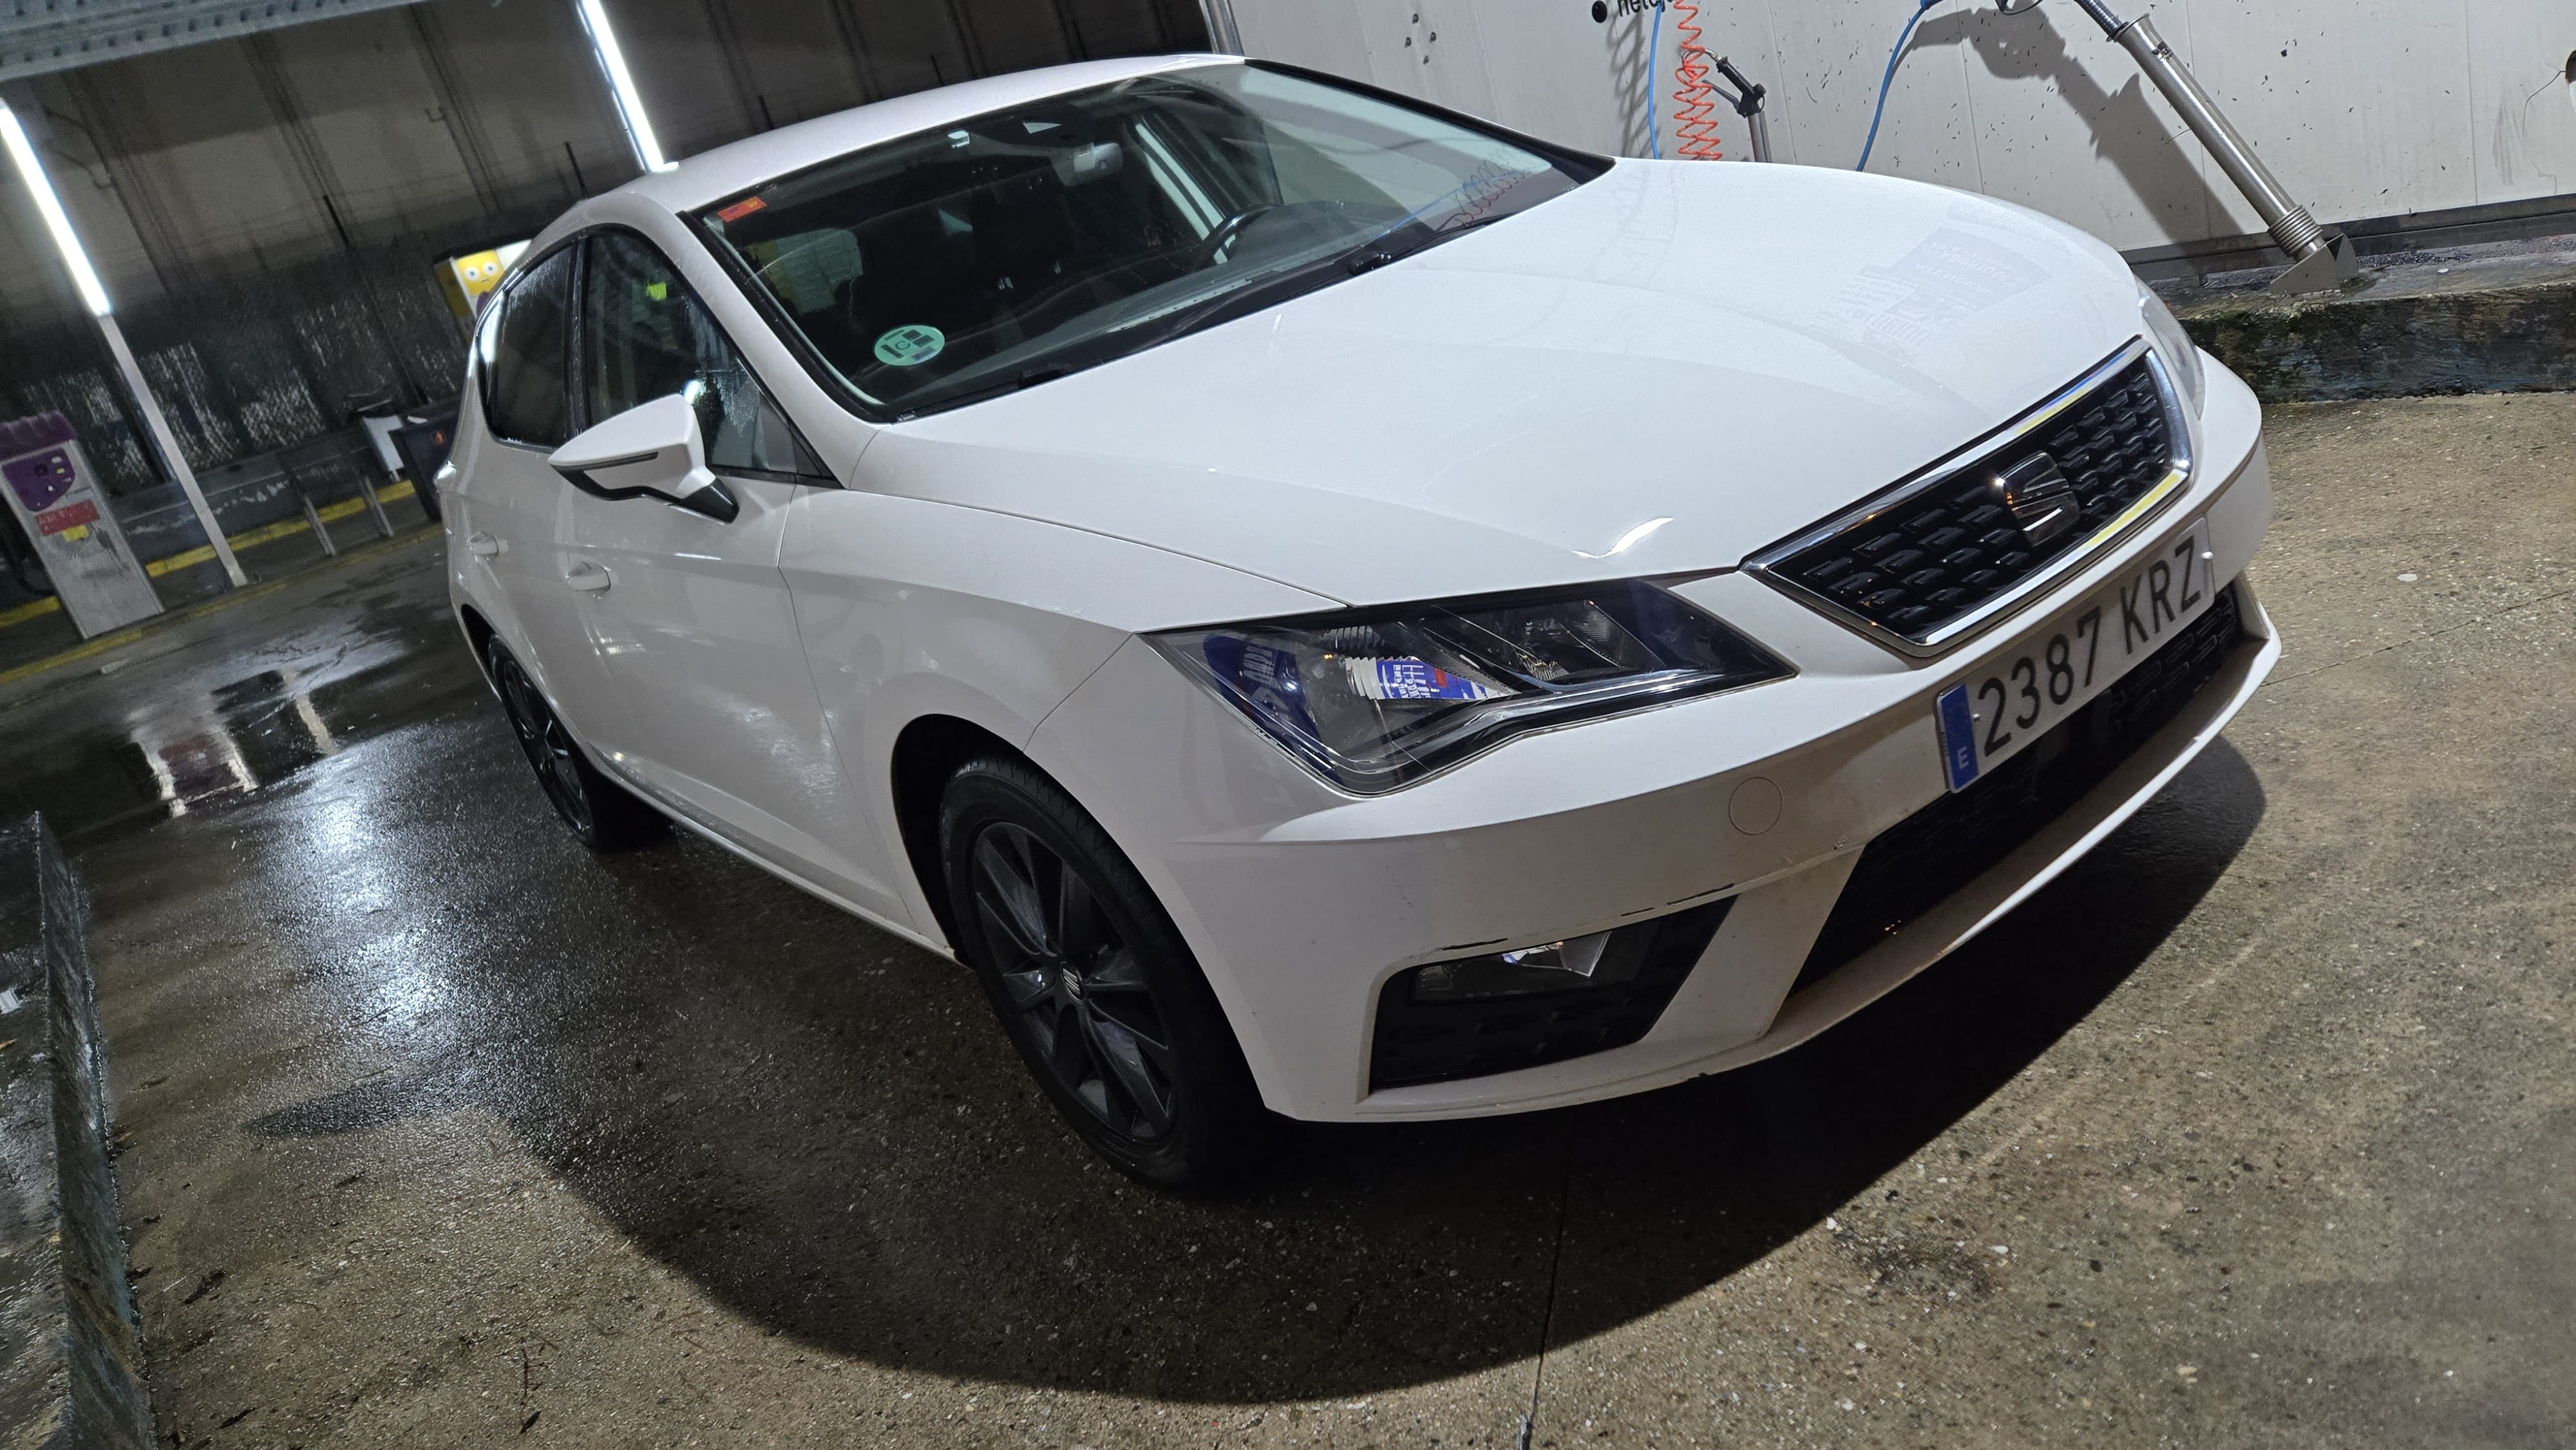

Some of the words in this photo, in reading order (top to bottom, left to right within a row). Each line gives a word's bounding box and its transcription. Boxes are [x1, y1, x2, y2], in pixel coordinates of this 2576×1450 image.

[1978, 607, 2101, 757] 2387
[2119, 536, 2201, 654] KRZ
[1957, 746, 1969, 770] E
